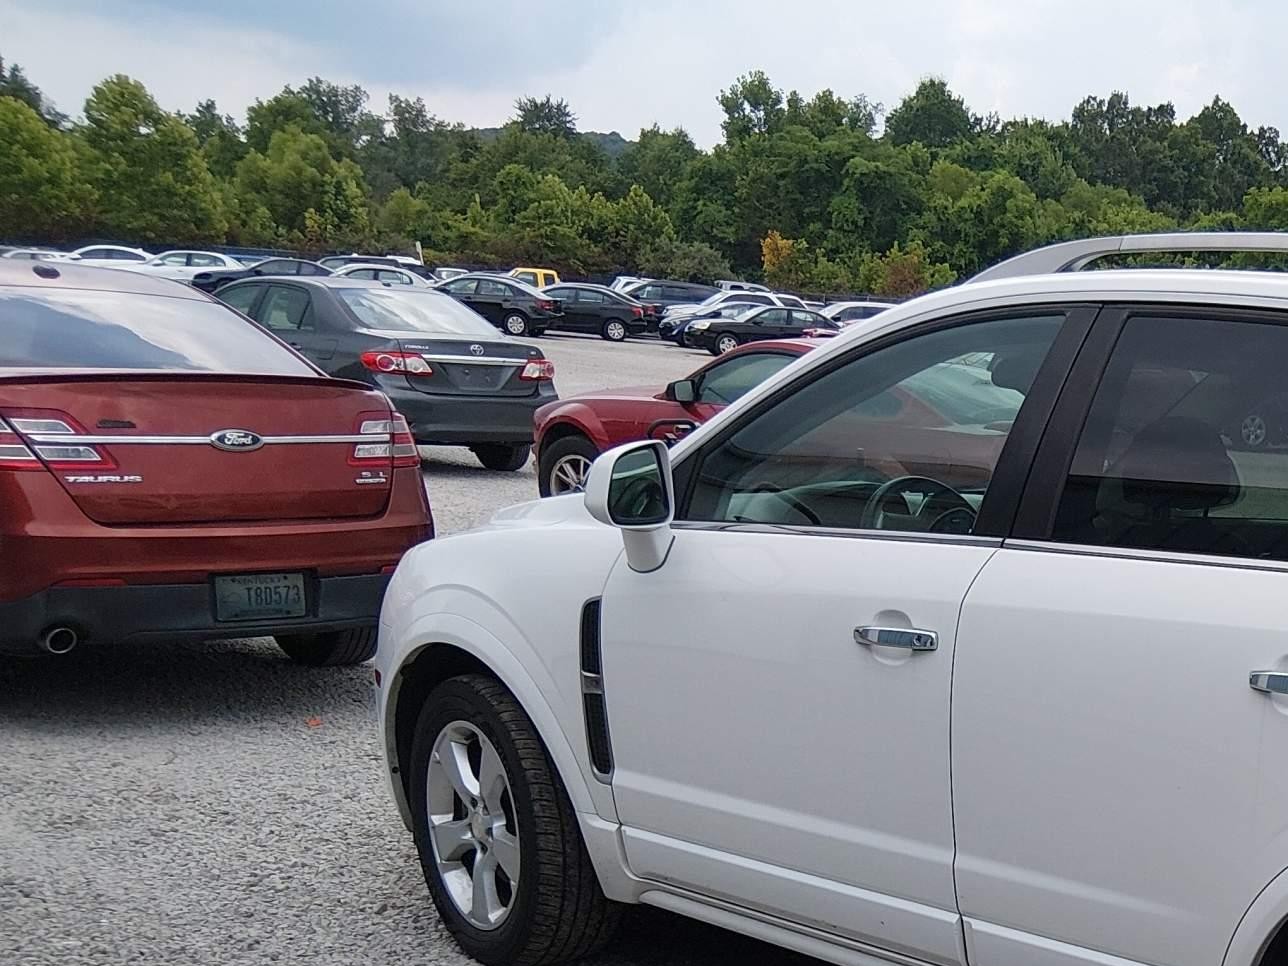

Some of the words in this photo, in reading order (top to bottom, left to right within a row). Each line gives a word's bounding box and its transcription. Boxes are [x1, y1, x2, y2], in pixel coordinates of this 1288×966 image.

[224, 432, 253, 445] Ford
[64, 475, 143, 483] TAURUS
[245, 585, 301, 606] T8D573
